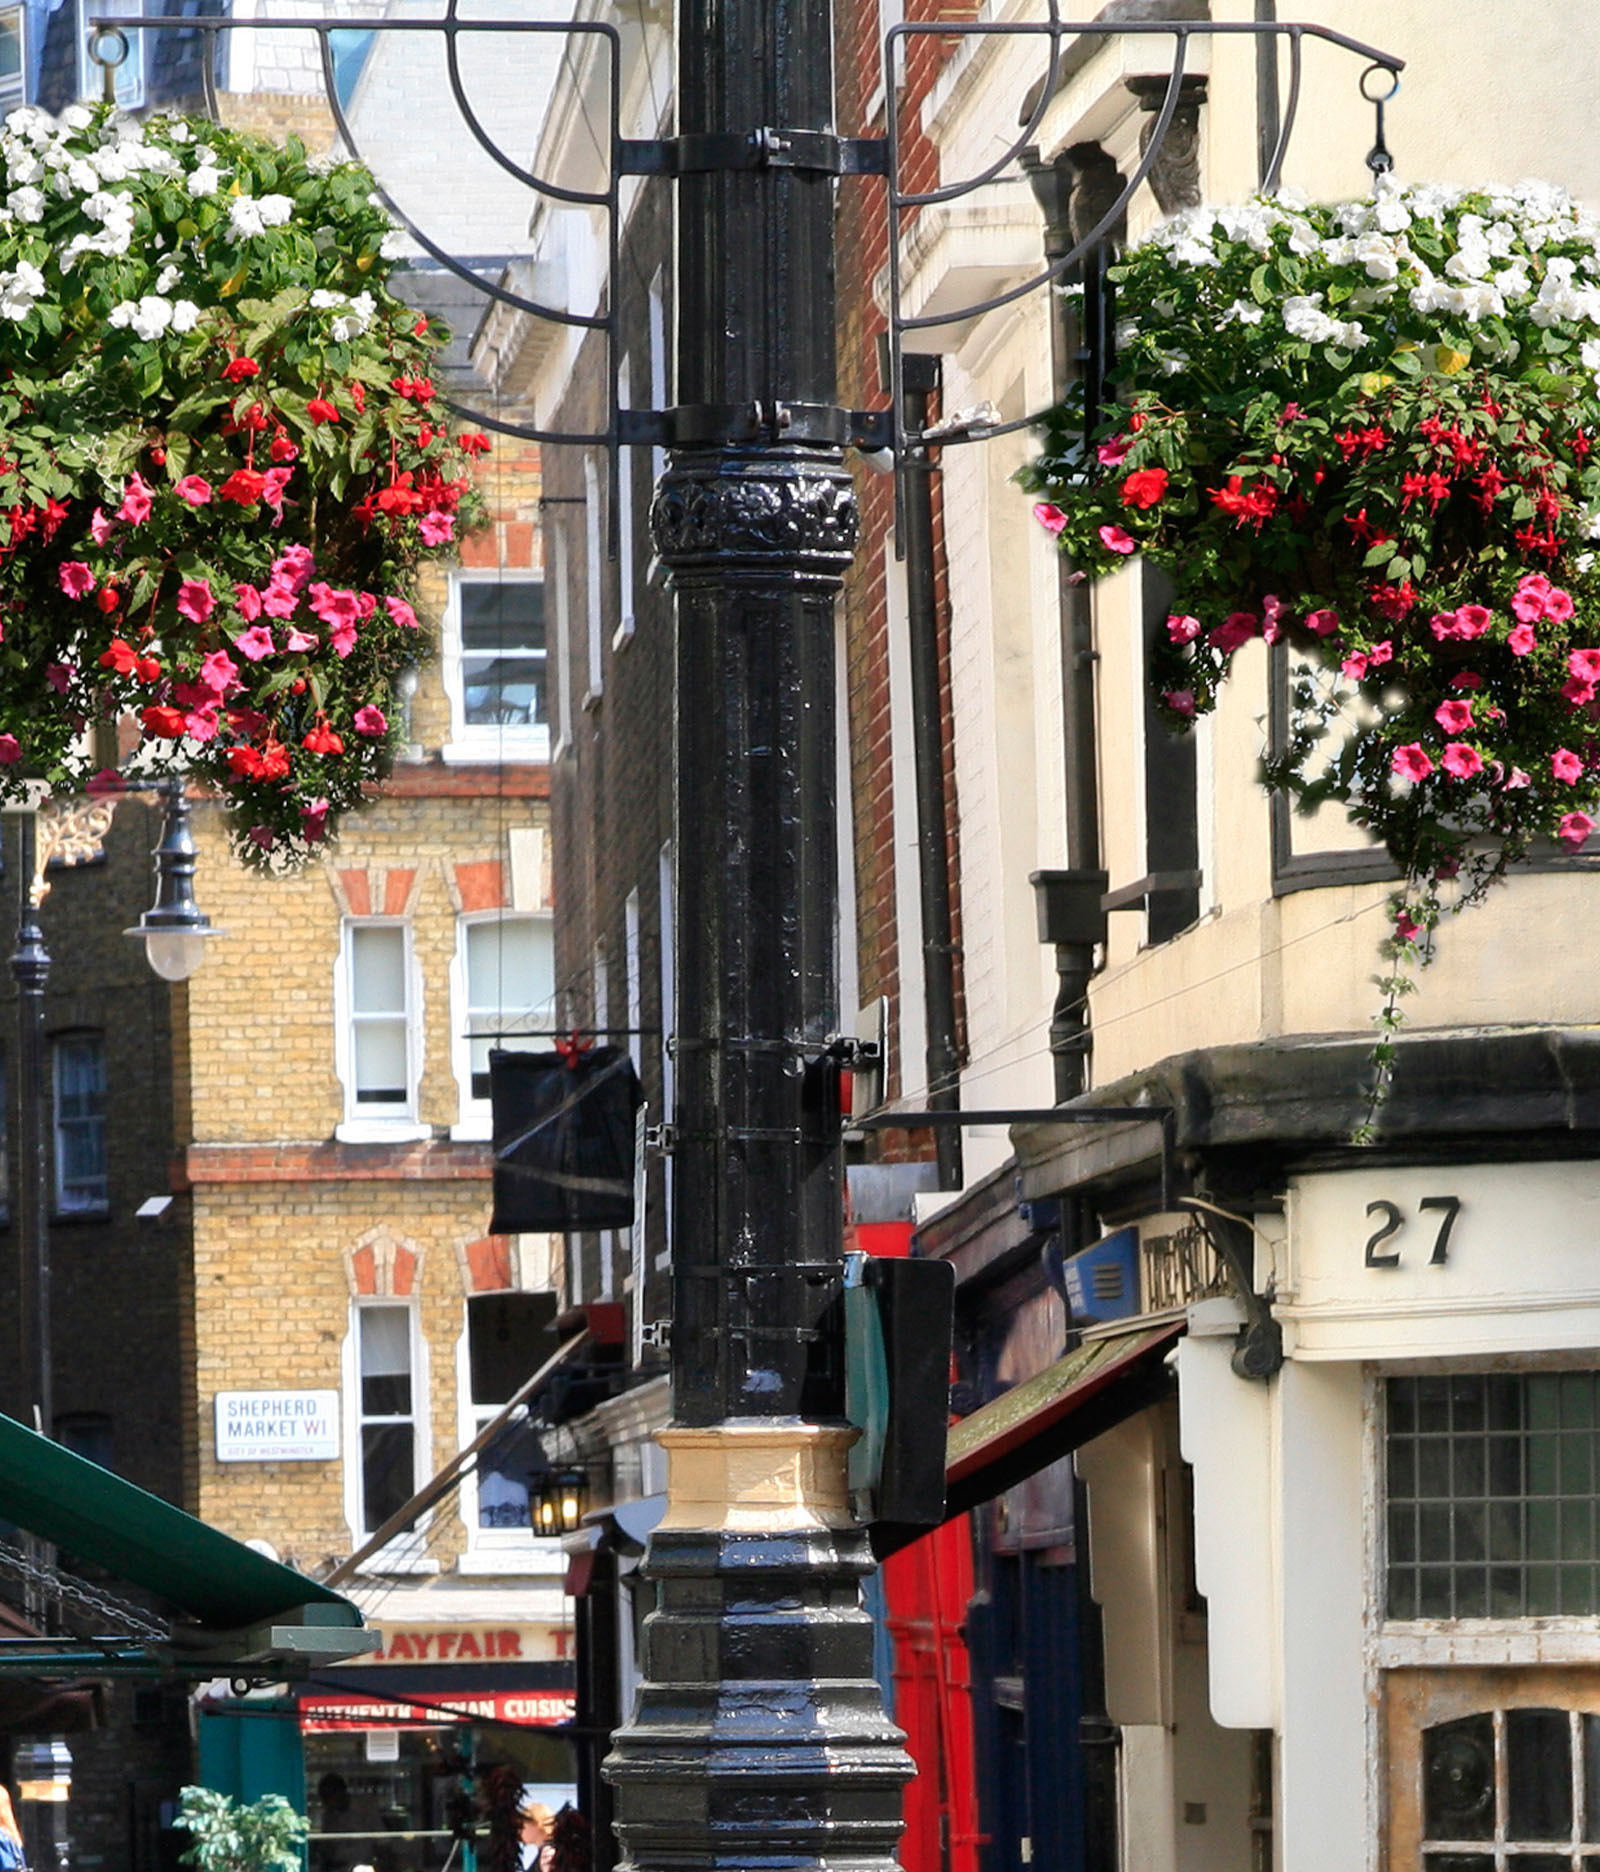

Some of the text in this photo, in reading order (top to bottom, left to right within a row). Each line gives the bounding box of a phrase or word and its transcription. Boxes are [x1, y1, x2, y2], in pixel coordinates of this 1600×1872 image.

[1364, 1196, 1461, 1268] 27
[228, 1399, 317, 1417] SHEPHERD
[228, 1419, 297, 1437] MARKET
[374, 1630, 575, 1660] AYFAIR T
